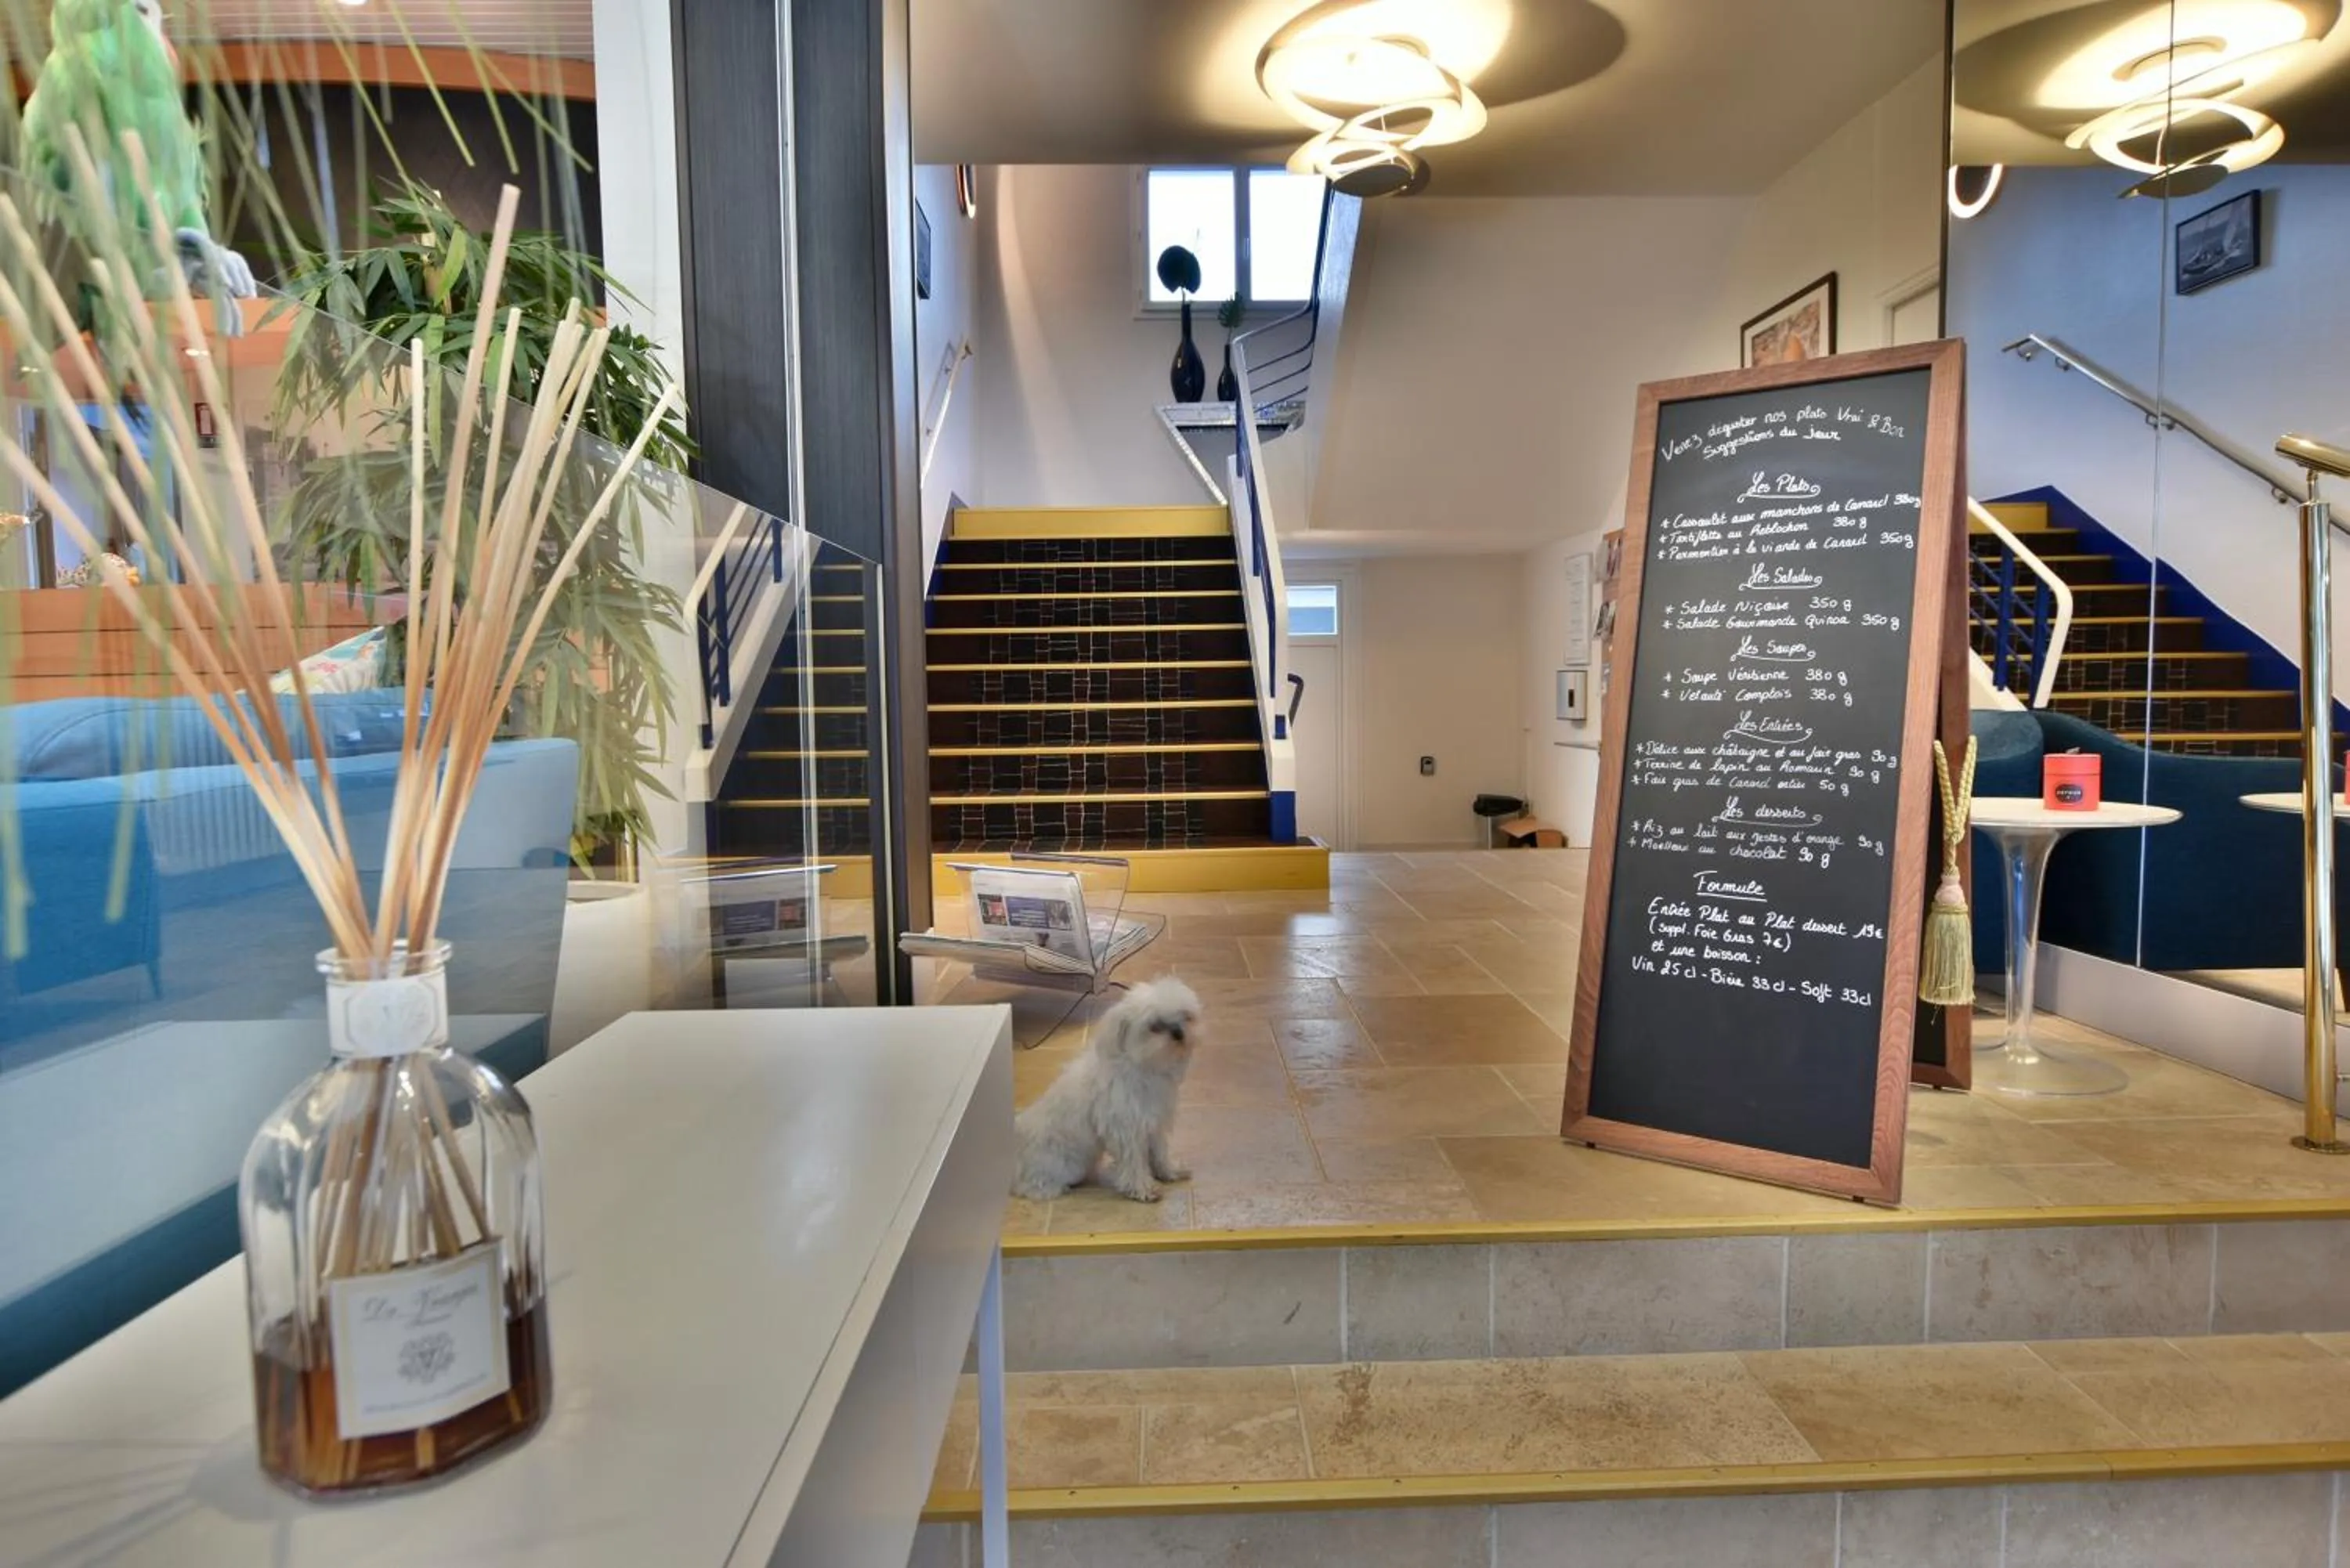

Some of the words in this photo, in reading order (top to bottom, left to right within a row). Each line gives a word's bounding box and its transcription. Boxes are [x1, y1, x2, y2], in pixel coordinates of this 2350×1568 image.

[1764, 410, 1787, 423] nos
[1796, 404, 1827, 422] plats
[1837, 406, 1864, 422] Vrai
[1880, 416, 1904, 438] Bon
[1703, 430, 1774, 460] Suggestions
[1779, 425, 1797, 436] du
[1802, 424, 1841, 441] jour
[1747, 471, 1770, 496] Les
[1776, 472, 1810, 493] Plats
[1827, 500, 1840, 512] de
[1833, 516, 1856, 527] 380
[1733, 543, 1740, 555] à
[1745, 539, 1757, 554] la
[1762, 539, 1801, 552] viande
[1805, 539, 1817, 550] de
[1748, 562, 1770, 587] Les
[1773, 566, 1813, 583] Salades
[1680, 598, 1726, 614] Salade
[1734, 597, 1789, 616] Niçoise
[1809, 596, 1838, 609] 350
[1842, 599, 1852, 612] g
[1676, 617, 1720, 630] Salade
[1726, 615, 1797, 629] Gourmande
[1804, 614, 1850, 629] Quinoa
[1861, 613, 1887, 626] 350
[1738, 634, 1759, 655] Les
[1766, 640, 1806, 657] Soupes
[1681, 668, 1717, 685] Soupe
[1805, 668, 1832, 681] 380
[1837, 670, 1847, 686] g
[1810, 688, 1836, 701] 380
[1843, 692, 1853, 706] g
[1734, 710, 1757, 731] Les
[1759, 717, 1802, 732] Entrées
[1683, 746, 1706, 755] aux
[1774, 746, 1786, 758] et
[1835, 751, 1861, 766] gras
[1643, 758, 1684, 770] Terrine
[1689, 759, 1701, 770] de
[1709, 757, 1749, 774] lapin
[1779, 760, 1835, 775] Romarin
[1871, 770, 1880, 784] g
[1672, 778, 1699, 792] gras
[1705, 774, 1723, 786] de
[1820, 779, 1835, 790] 50
[1840, 783, 1849, 797] g
[1720, 795, 1744, 819] Les
[1755, 804, 1806, 818] desserts
[1643, 818, 1664, 838] Riz
[1670, 827, 1684, 836] au
[1693, 823, 1719, 837] lait
[1726, 831, 1745, 840] aux
[1730, 844, 1788, 859] chocolat
[1821, 853, 1830, 869] g
[1693, 870, 1765, 895] Formule
[1647, 896, 1691, 916] Entrée
[1698, 905, 1730, 923] Plat
[1765, 911, 1795, 929] Plat
[1802, 919, 1848, 936] dessert
[1694, 923, 1718, 939] Foie
[1723, 929, 1755, 944] Gras
[1651, 939, 1665, 952] et
[1669, 946, 1696, 957] une
[1632, 956, 1655, 972] Vin
[1801, 981, 1832, 1003] Soft
